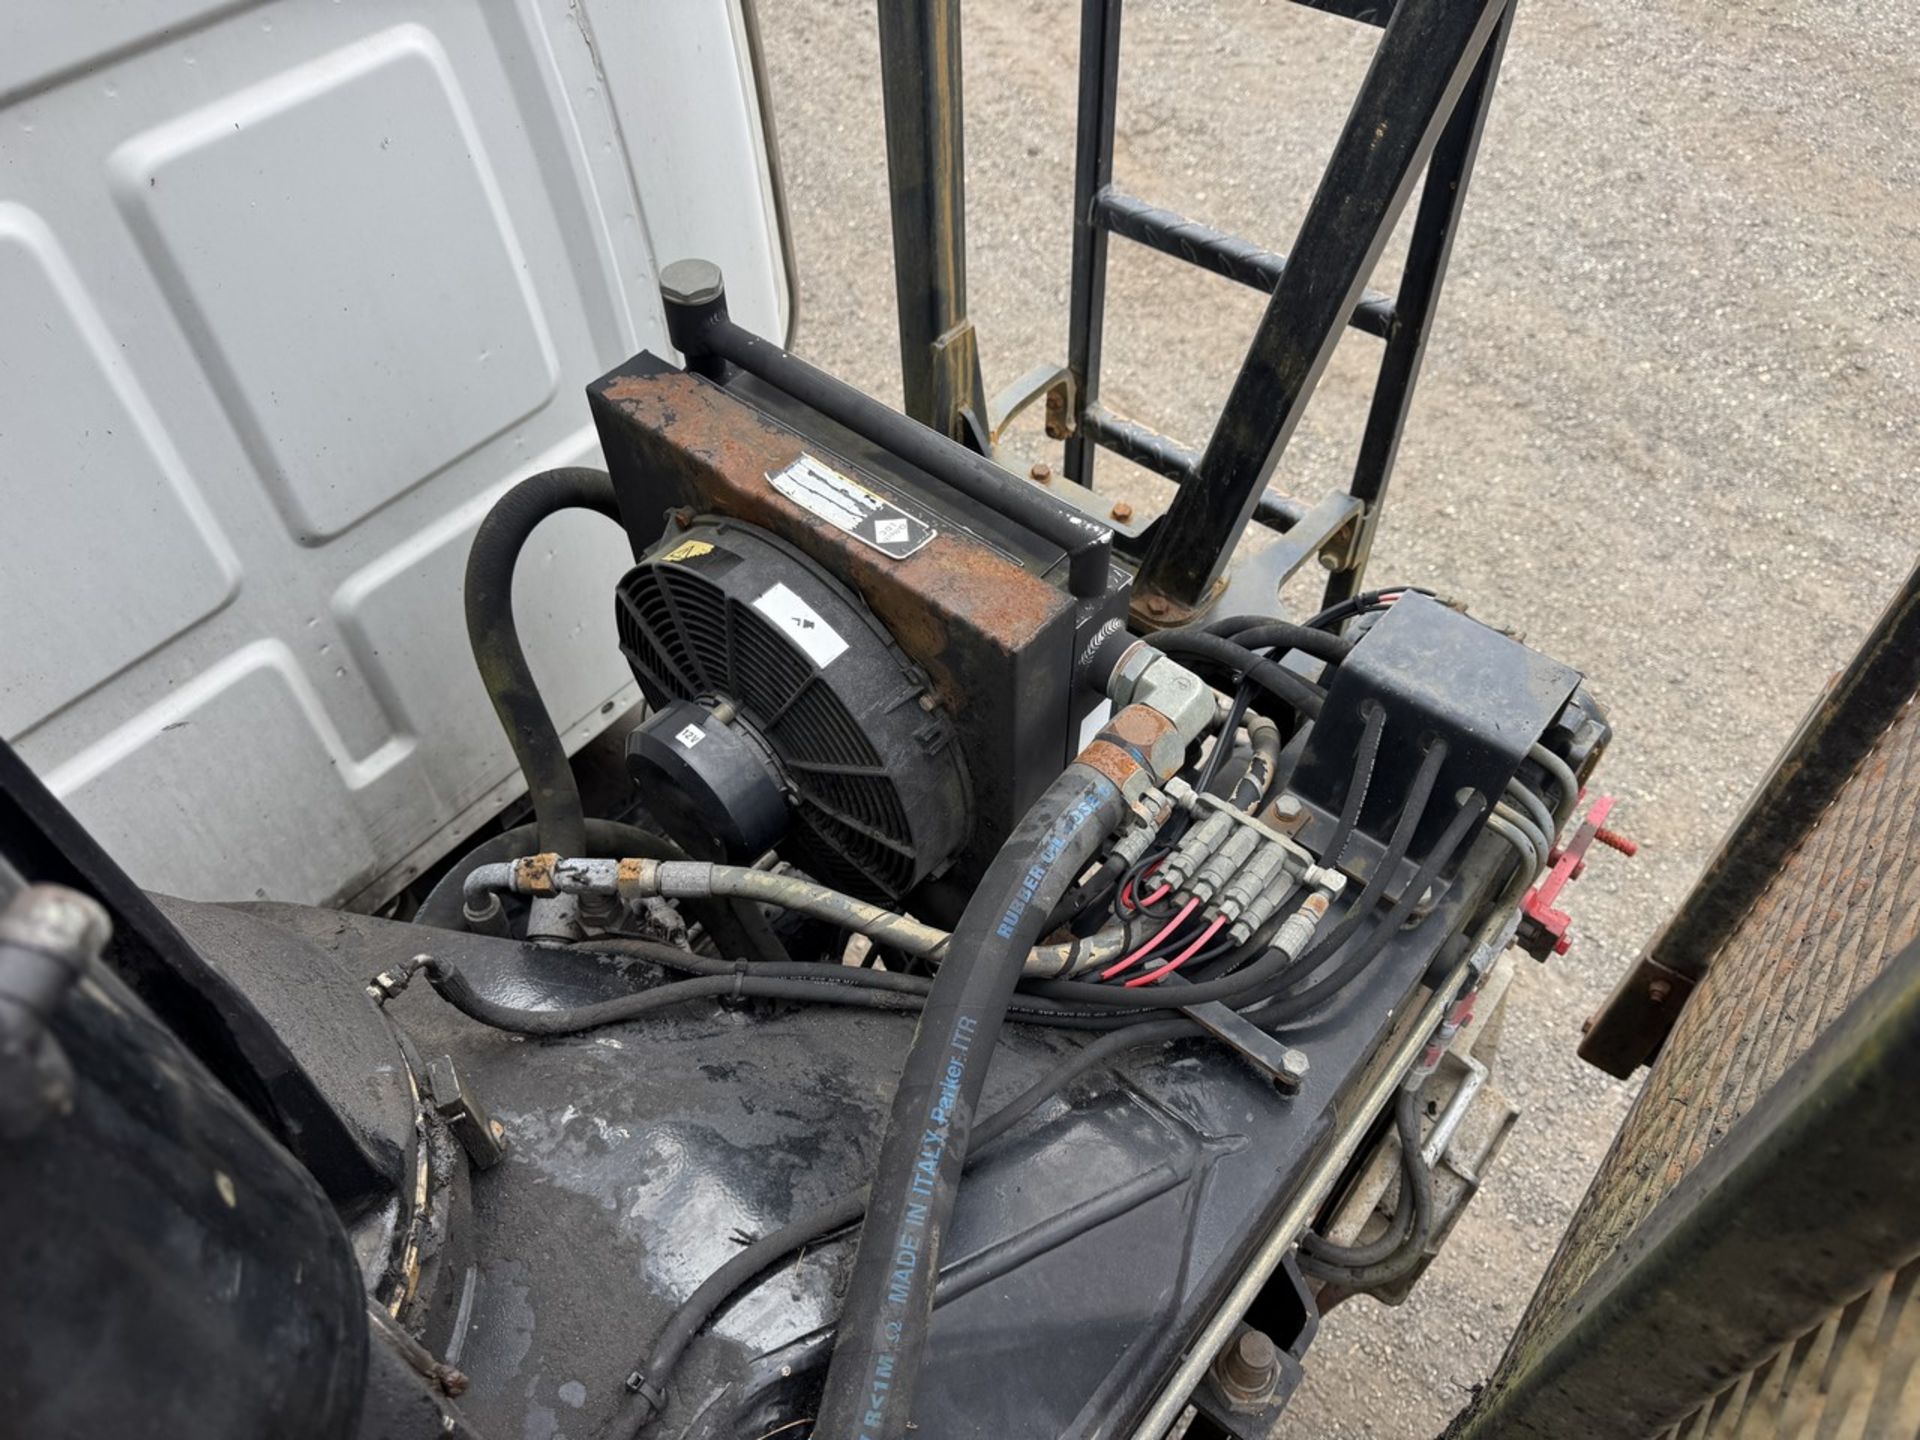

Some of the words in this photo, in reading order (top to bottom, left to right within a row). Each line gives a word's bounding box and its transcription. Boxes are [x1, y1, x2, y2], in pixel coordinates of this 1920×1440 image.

[682, 729, 700, 743] 12V
[997, 862, 1046, 939] RUBBER
[951, 1016, 977, 1051] ITR
[930, 1056, 965, 1126] Parker
[912, 1128, 944, 1196] ITALY
[905, 1202, 928, 1227] IN
[888, 1233, 920, 1303] MADE
